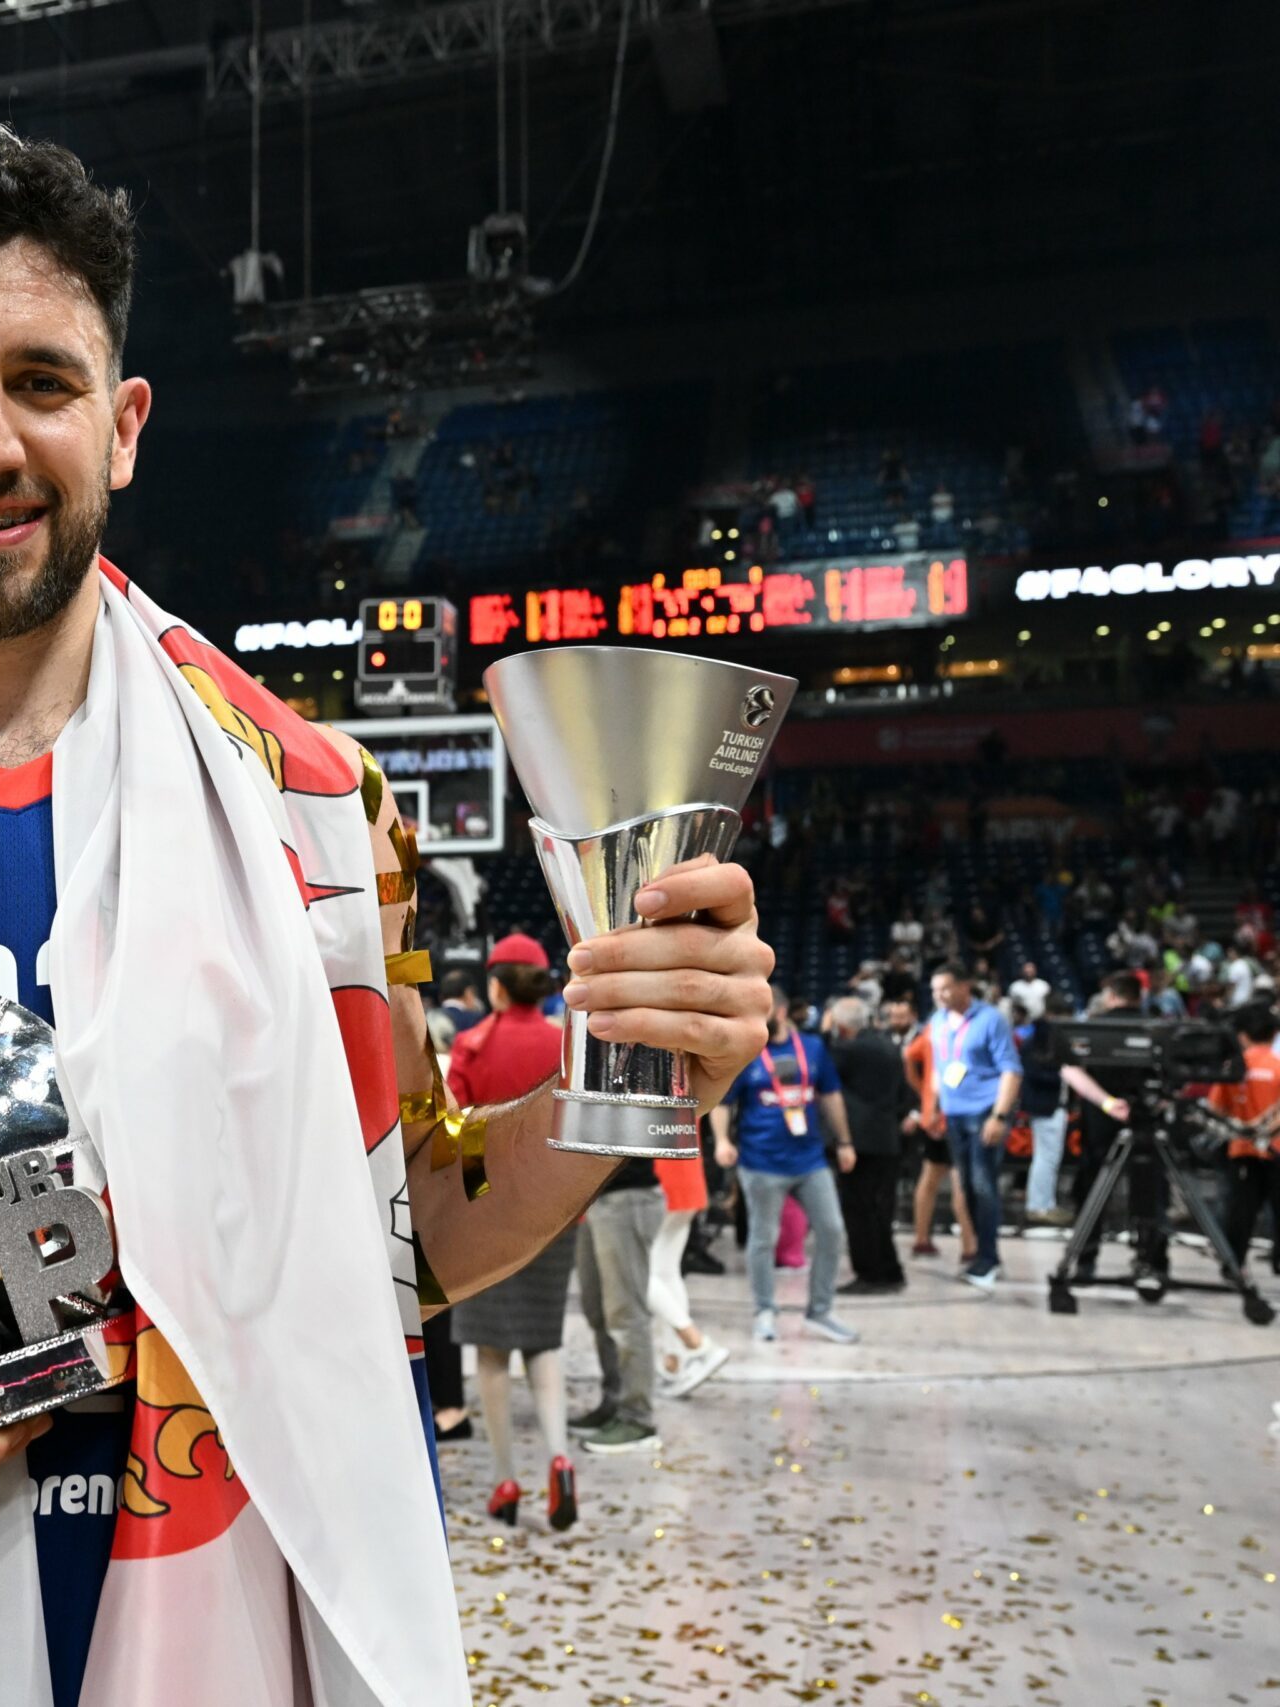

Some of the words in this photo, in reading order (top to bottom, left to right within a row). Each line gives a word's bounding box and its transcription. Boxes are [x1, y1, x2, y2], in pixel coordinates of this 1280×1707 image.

[722, 730, 766, 750] TURKISH
[714, 744, 760, 764] AIRLINES
[29, 1474, 126, 1516] ren
